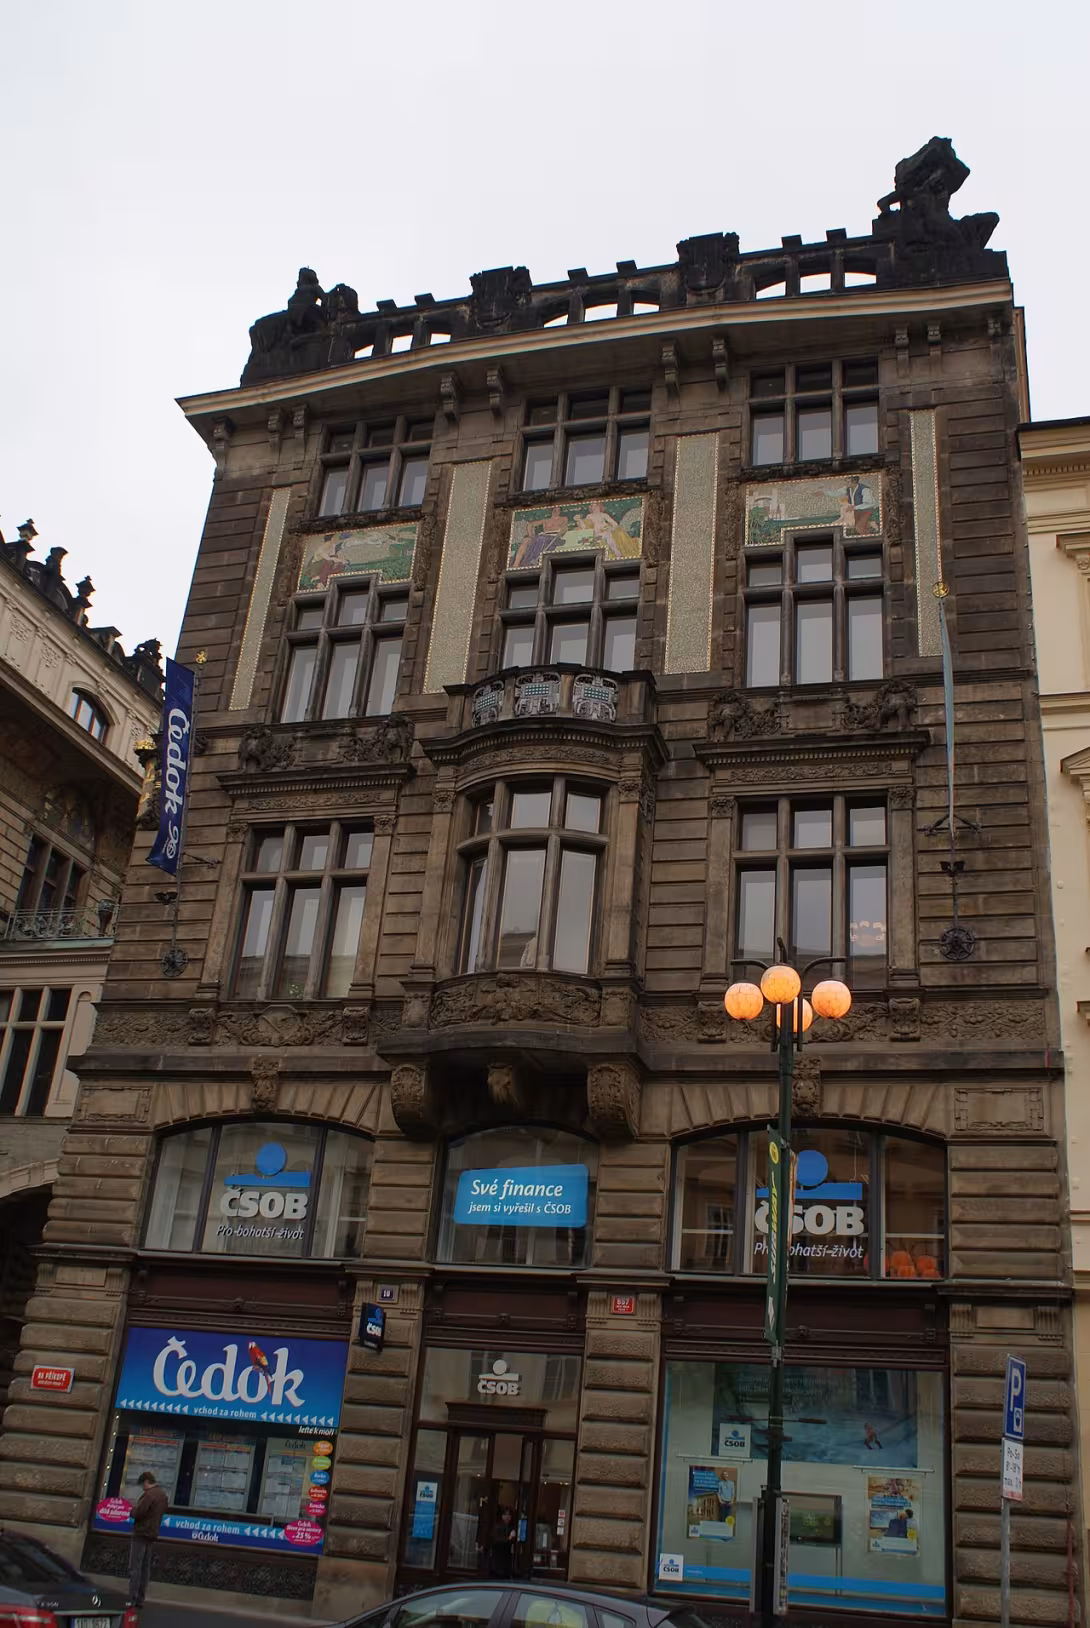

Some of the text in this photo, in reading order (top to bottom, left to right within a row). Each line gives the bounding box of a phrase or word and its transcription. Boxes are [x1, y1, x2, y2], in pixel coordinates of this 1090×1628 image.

[165, 708, 190, 815] Čedok
[471, 1178, 563, 1200] Své finance
[220, 1186, 309, 1220] ČSOB
[468, 1201, 571, 1215] jsem si vyřešil s ČSOB
[153, 1336, 305, 1408] Čedok
[477, 1378, 519, 1396] ČSOB
[1010, 1367, 1022, 1412] P
[193, 1405, 218, 1416] vchod
[230, 1407, 257, 1419] rohem
[175, 1519, 240, 1535] vchod za rohem
